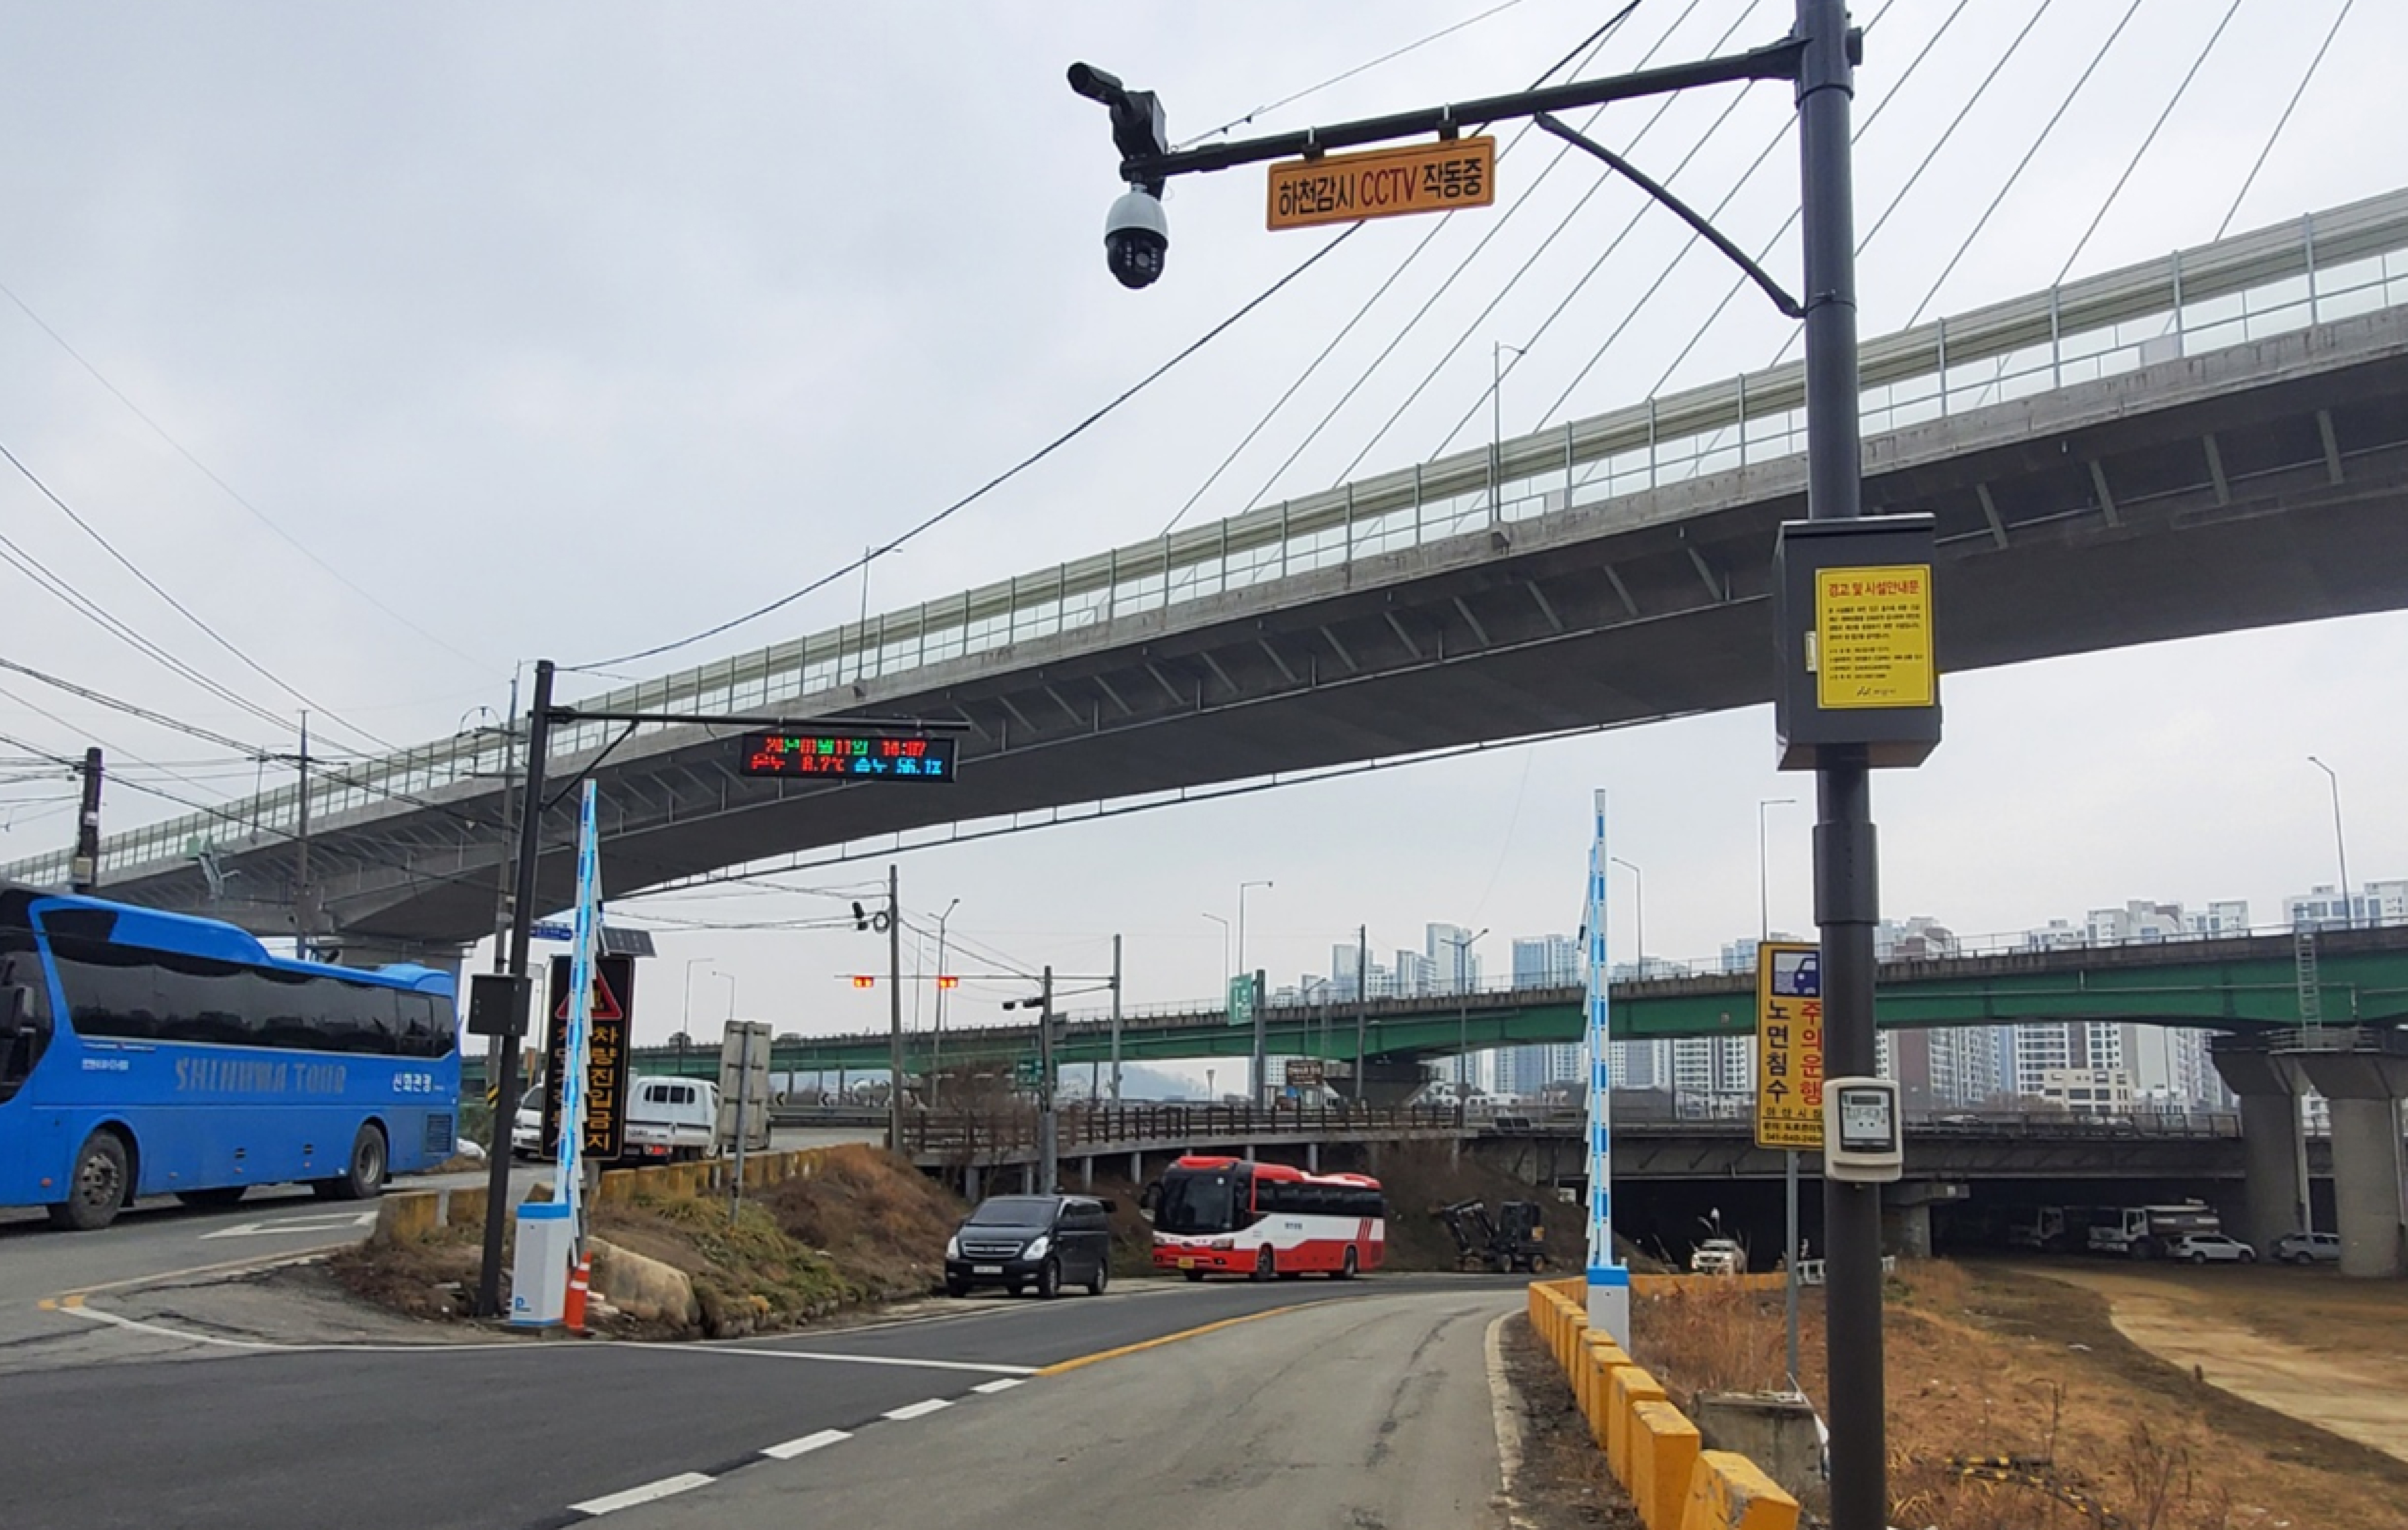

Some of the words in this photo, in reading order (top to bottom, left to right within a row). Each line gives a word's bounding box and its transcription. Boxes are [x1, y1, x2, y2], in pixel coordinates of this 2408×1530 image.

[1278, 173, 1355, 217] 하천감시
[1360, 164, 1418, 207] CCTV
[1423, 157, 1482, 199] 작동중
[587, 1026, 620, 1151] 차량진입금지
[1766, 1000, 1790, 1104] 노면침수
[1801, 1001, 1822, 1106] 주의운행
